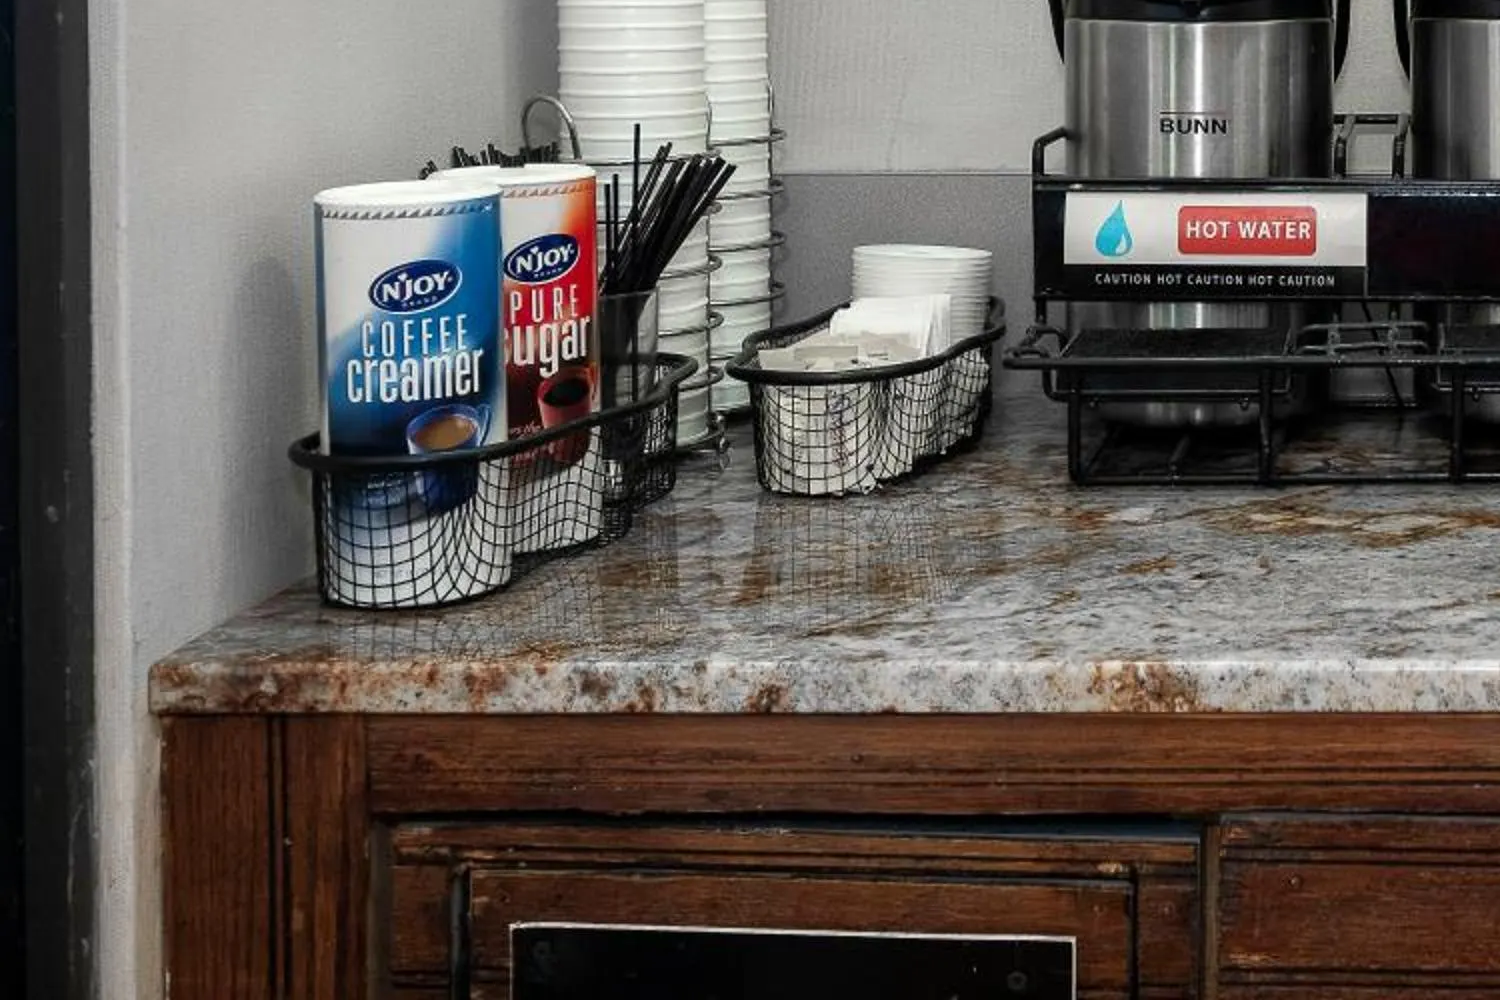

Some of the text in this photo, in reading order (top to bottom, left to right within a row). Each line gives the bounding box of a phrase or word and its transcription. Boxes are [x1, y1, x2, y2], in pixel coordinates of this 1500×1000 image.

[1159, 117, 1228, 134] BUNN
[1186, 219, 1311, 240] HOT WATER
[1095, 273, 1335, 287] CAUTION HOT CAUTION HOT CAUTION
[510, 284, 580, 326] PURE
[362, 313, 469, 357] COFFEE
[347, 347, 483, 404] creamer
